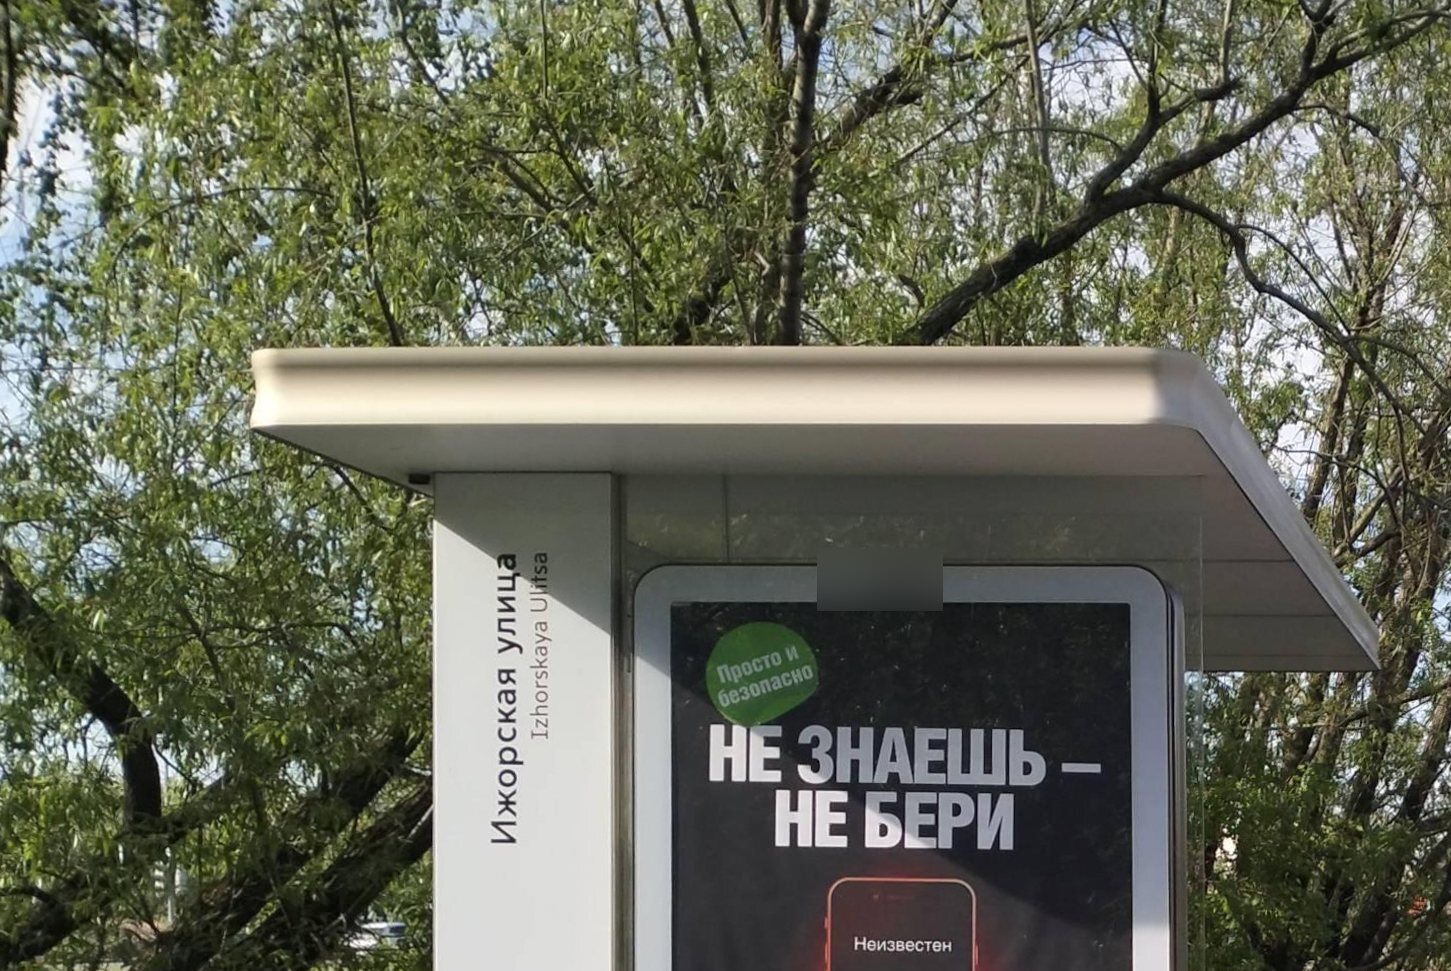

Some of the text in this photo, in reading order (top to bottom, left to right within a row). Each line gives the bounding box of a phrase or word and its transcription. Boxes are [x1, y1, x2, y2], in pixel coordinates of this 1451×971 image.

[530, 552, 552, 740] Izhorskaya Ulitsa
[716, 645, 800, 683] Просто и
[491, 553, 524, 843] Ижорская улица
[718, 664, 814, 708] безопасно
[709, 724, 782, 783] НЕ
[797, 724, 1047, 786] ЗНАЕШЬ
[774, 789, 1015, 851] НЕ БЕРИ
[853, 936, 953, 953] Неизвестен
